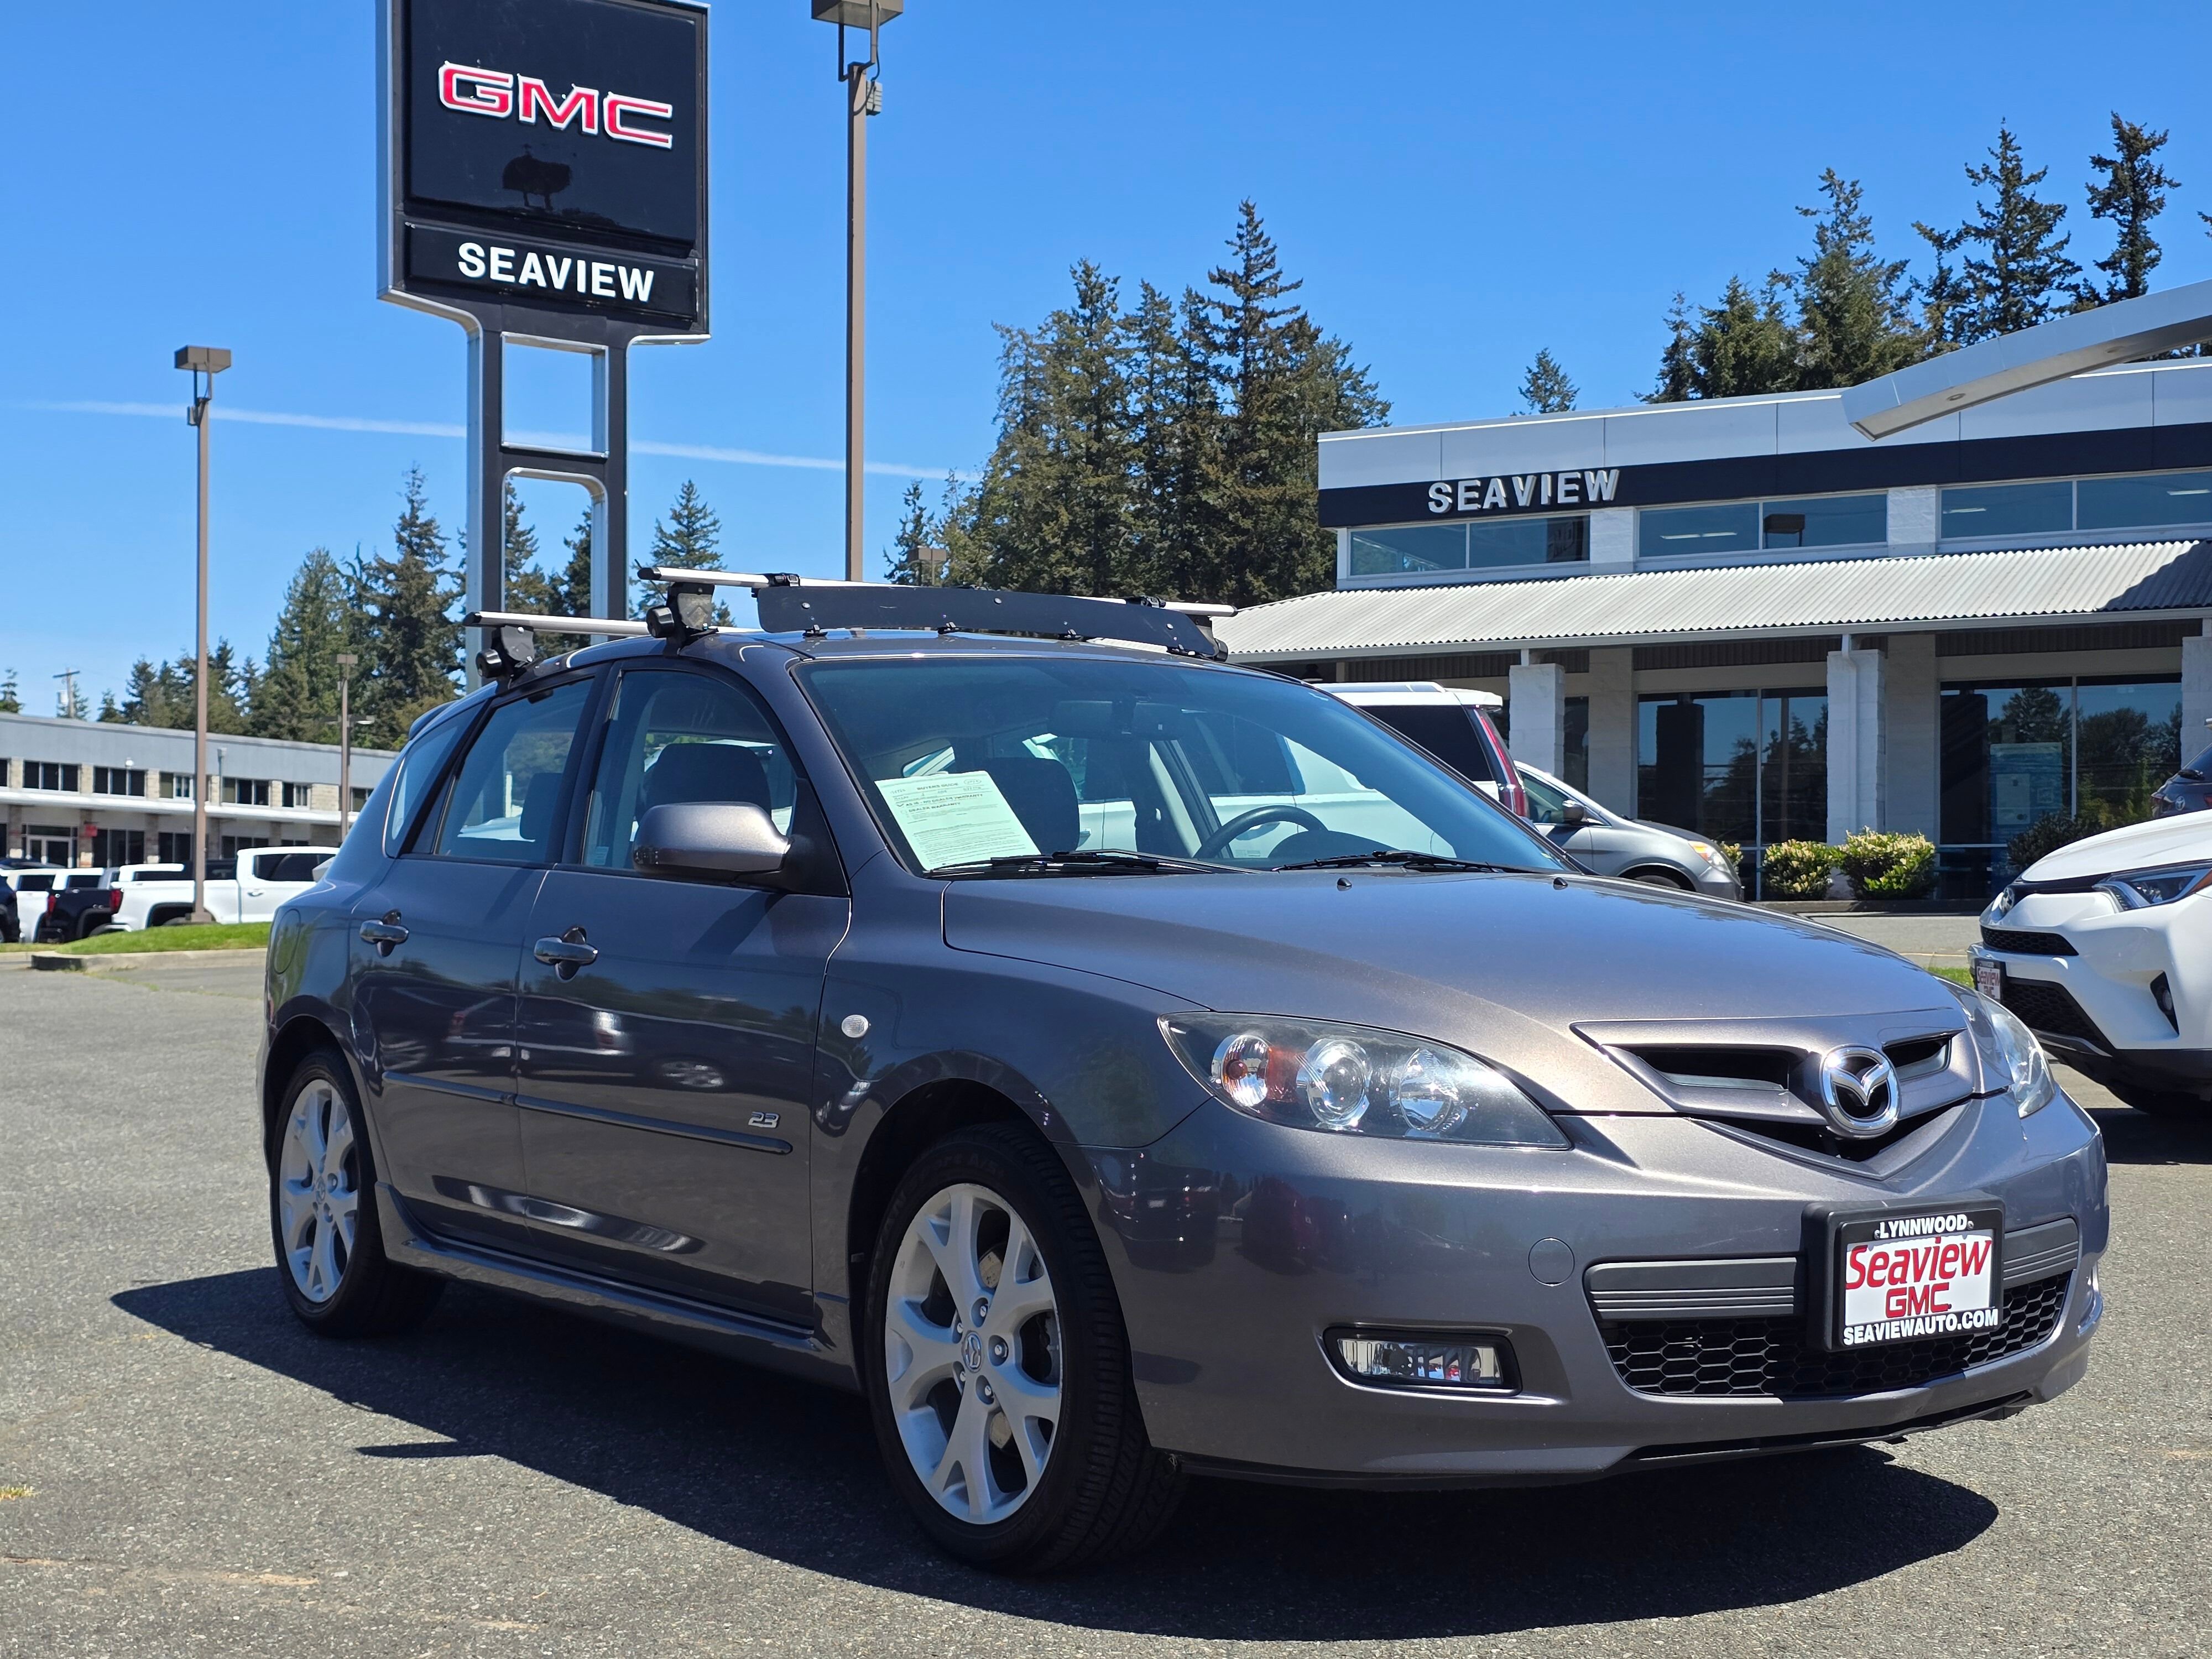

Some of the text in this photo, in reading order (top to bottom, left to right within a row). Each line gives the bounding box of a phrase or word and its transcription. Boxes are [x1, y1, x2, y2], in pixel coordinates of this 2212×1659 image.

[439, 61, 672, 150] GMC
[458, 242, 654, 302] SEAVIEW
[1428, 469, 1620, 514] SEAVIEW
[1880, 1214, 1968, 1239] LYNNWOOD
[1845, 1236, 1992, 1290] Seaview
[1885, 1282, 1950, 1318] GMC
[1843, 1309, 1998, 1345] SEAVIEWAUTO.COM
